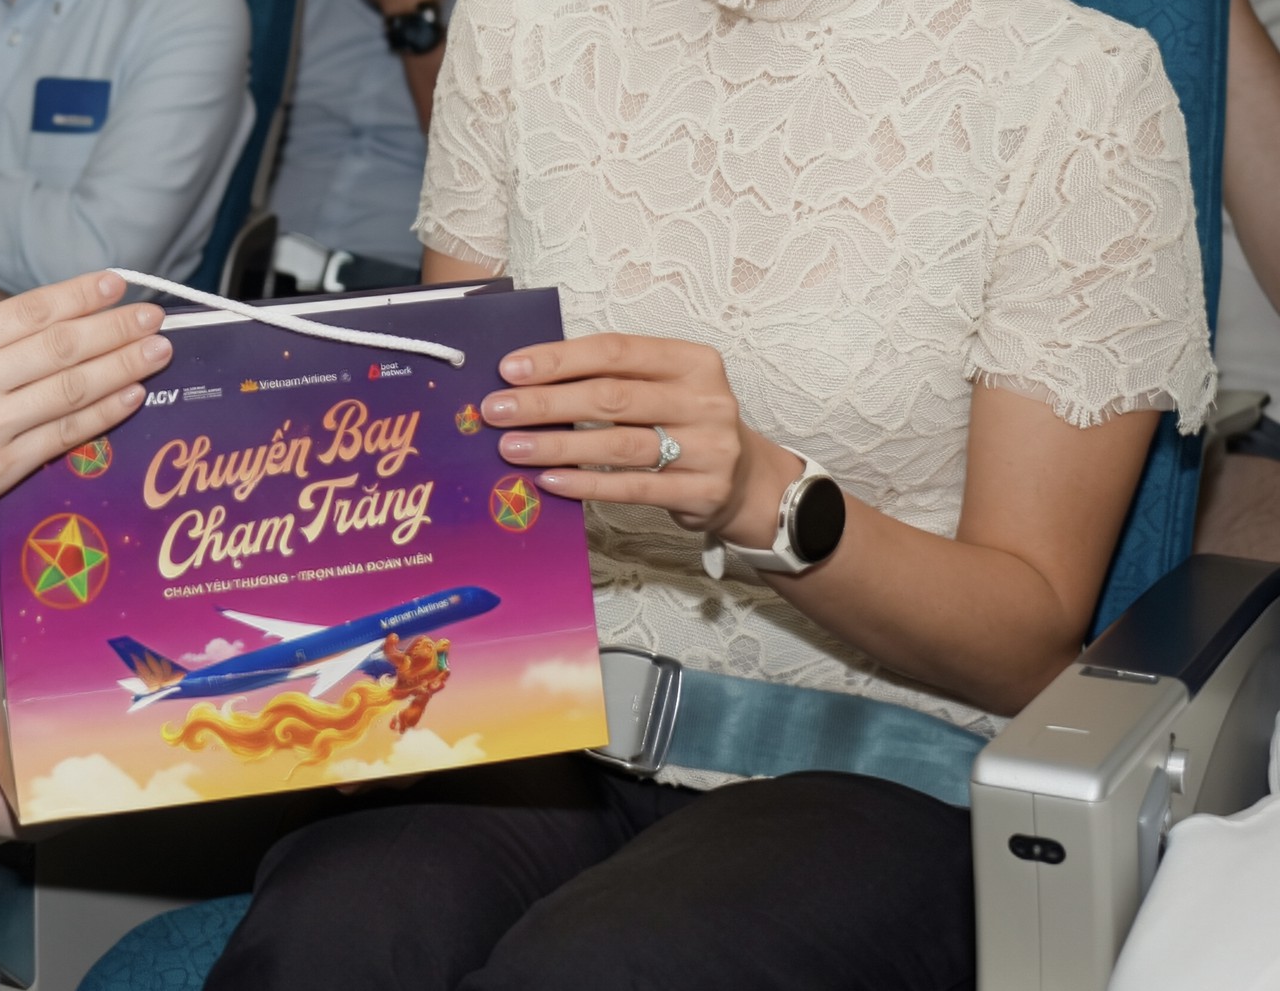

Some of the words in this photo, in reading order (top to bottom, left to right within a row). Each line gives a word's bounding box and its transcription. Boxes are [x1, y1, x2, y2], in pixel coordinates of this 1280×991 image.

[381, 366, 412, 377] network
[145, 389, 179, 406] ACV
[143, 419, 310, 509] Chuyến
[317, 398, 421, 477] Bay
[158, 505, 296, 579] Chạm
[298, 473, 434, 545] Trăng
[163, 584, 203, 599] CHẠM
[298, 567, 335, 581] TRỌN
[336, 561, 365, 576] MÙA
